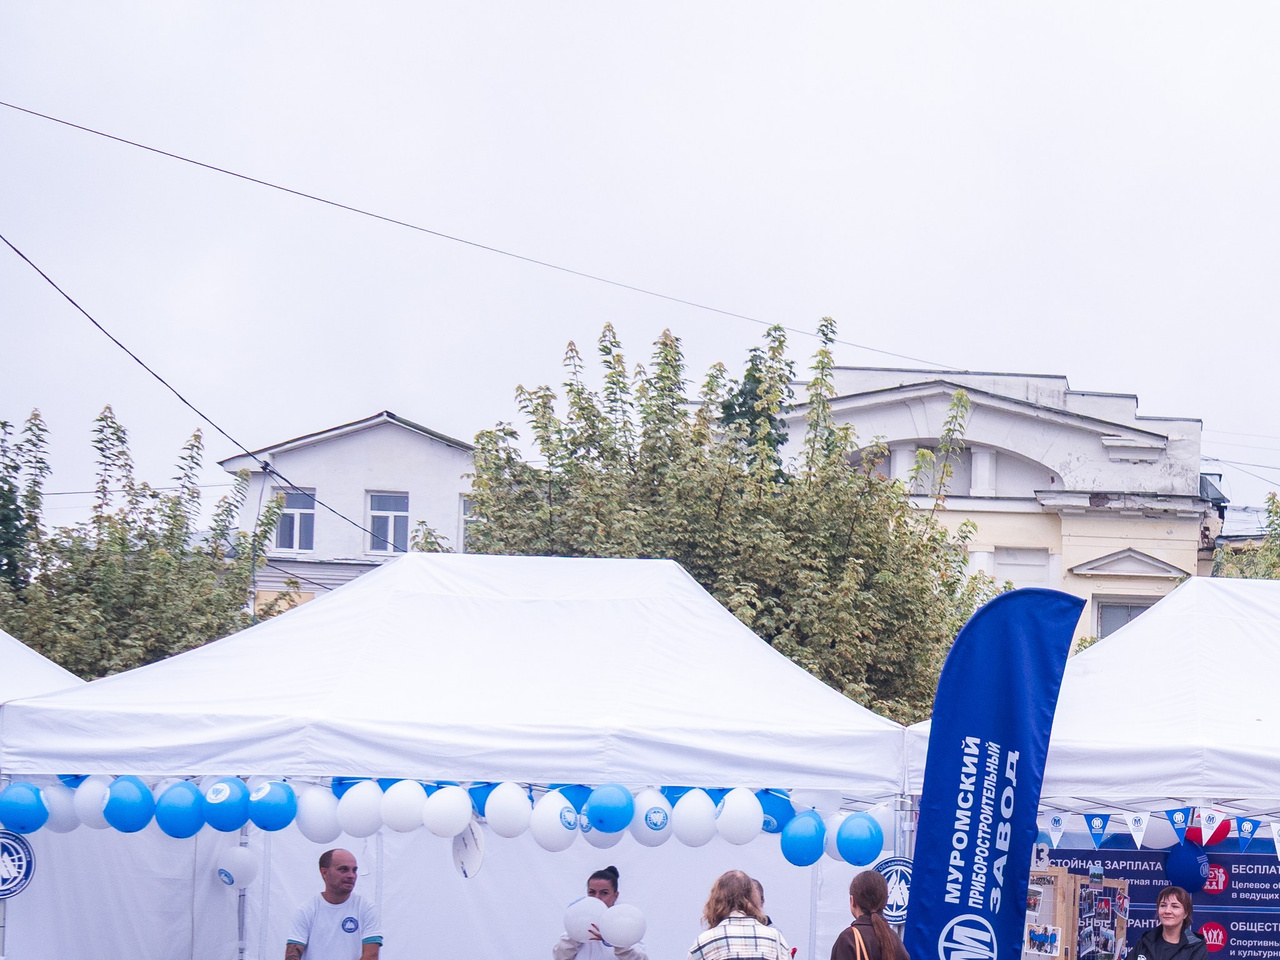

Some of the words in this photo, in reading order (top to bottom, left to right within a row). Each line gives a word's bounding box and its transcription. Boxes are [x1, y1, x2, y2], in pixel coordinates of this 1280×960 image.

[945, 736, 981, 904] МУРОМСКИЙ
[968, 741, 1001, 909] ПРИБОРОСТРОИТЕЛЬНЫЙ
[990, 750, 1020, 914] ЗАВОД
[1105, 860, 1163, 871] ЗАРПЛАТА
[1231, 880, 1271, 890] Целевое
[1239, 892, 1280, 901] ведущих
